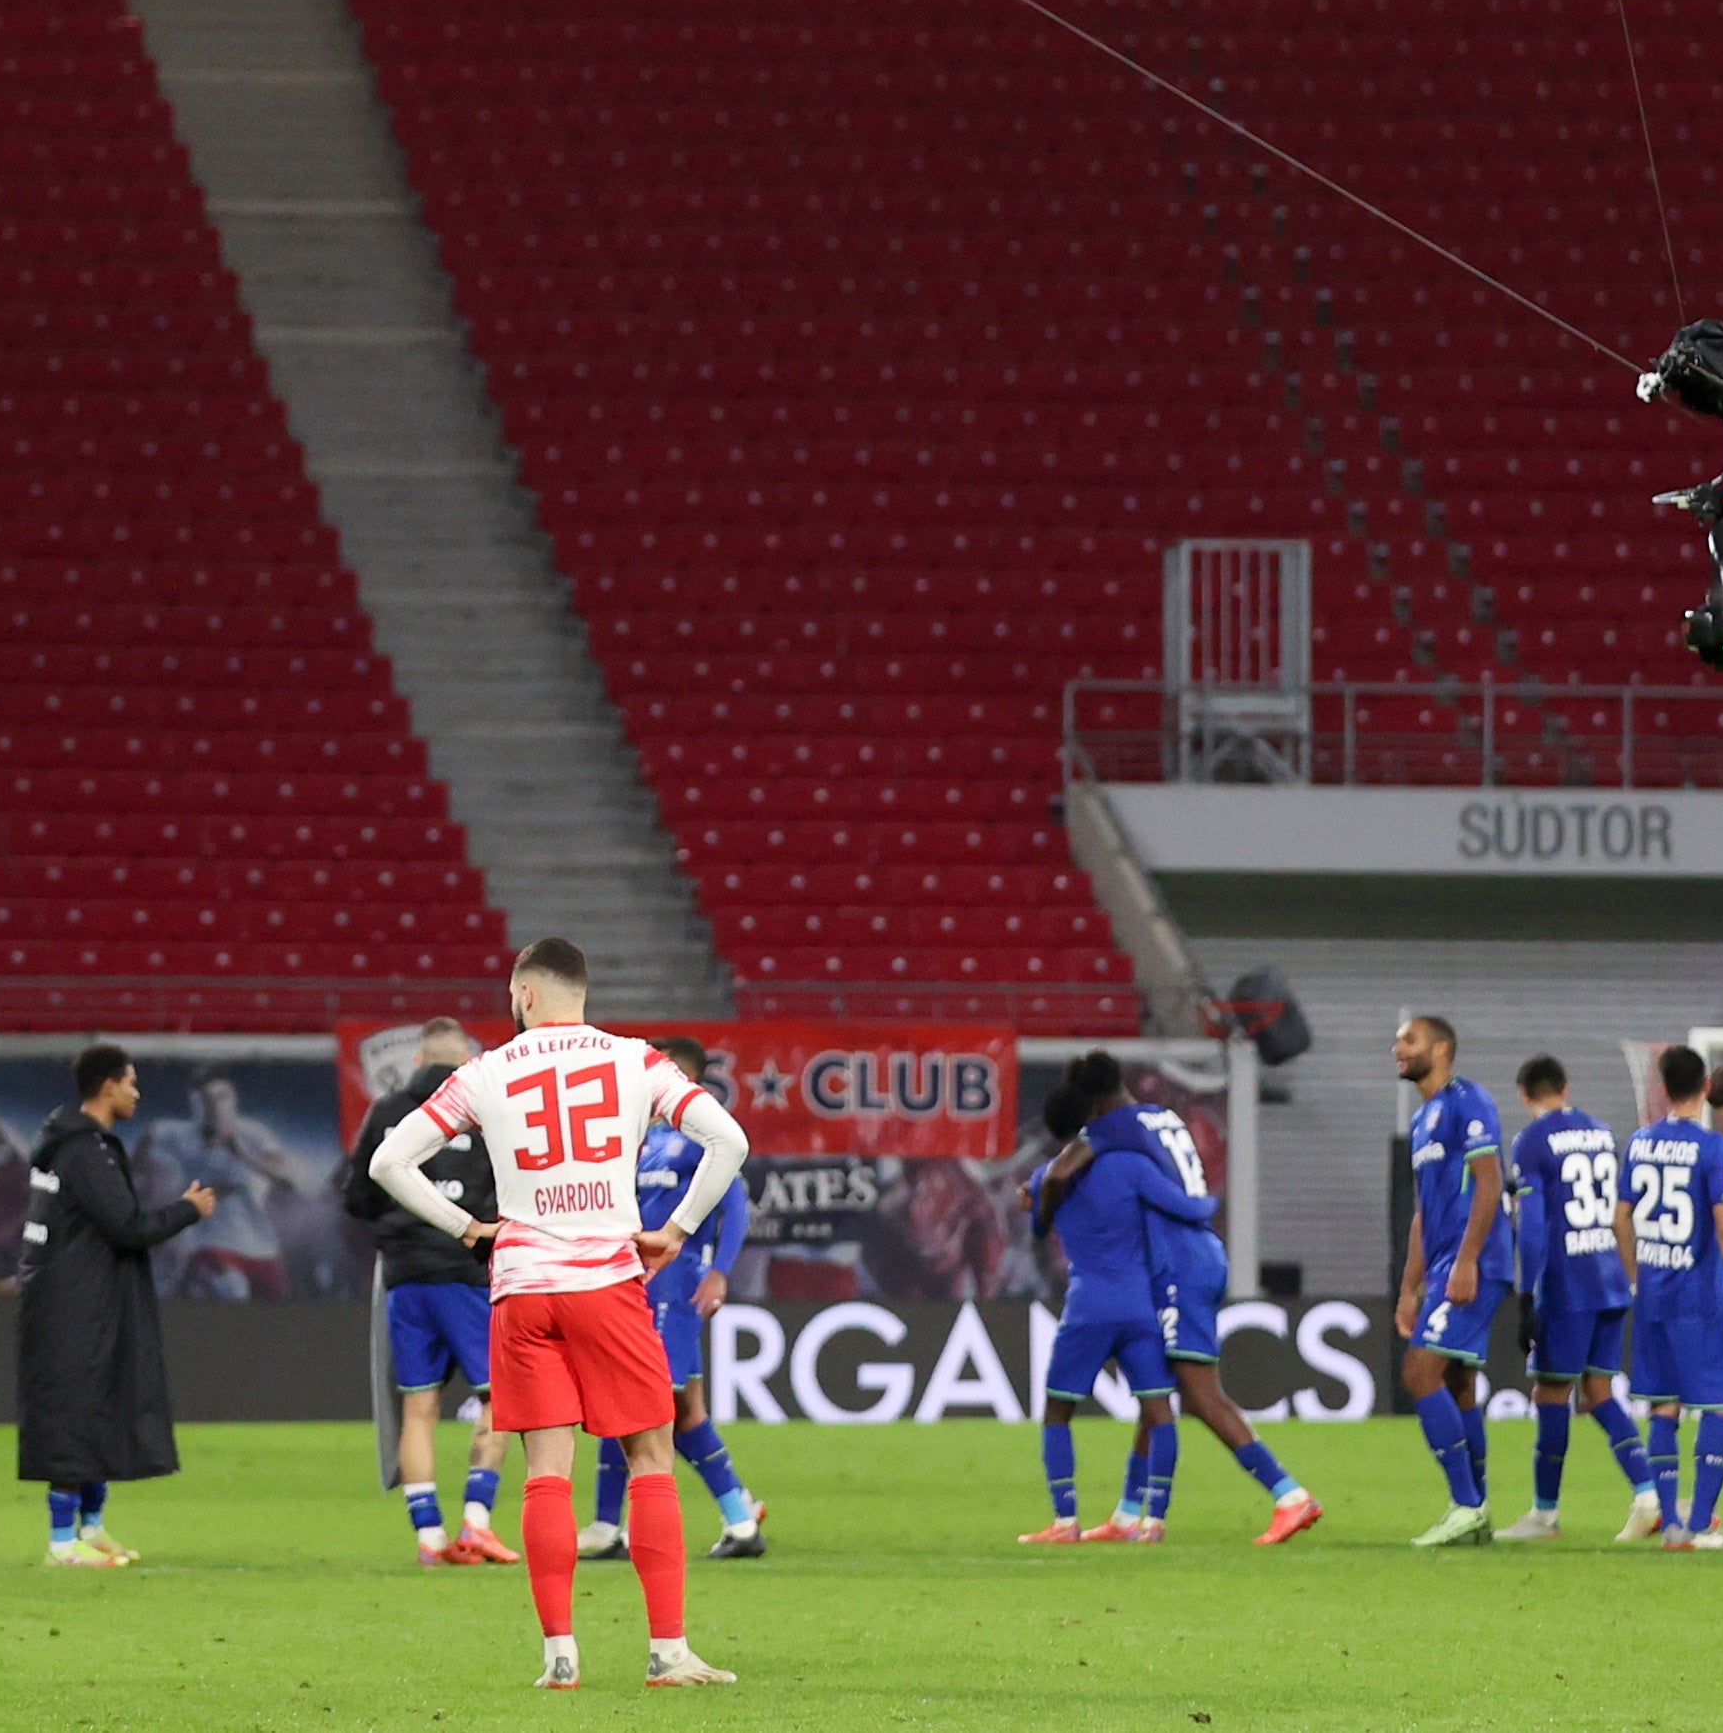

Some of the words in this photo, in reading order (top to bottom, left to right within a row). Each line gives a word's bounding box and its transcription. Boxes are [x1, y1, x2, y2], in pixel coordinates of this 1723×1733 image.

[505, 1044, 531, 1063] RB
[537, 1035, 613, 1055] LEIPZIG
[801, 1049, 1002, 1120] CLUB
[506, 1061, 623, 1171] 32
[1628, 1138, 1700, 1166] PALACIOS
[1561, 1152, 1619, 1229] 33
[1630, 1163, 1694, 1244] 25
